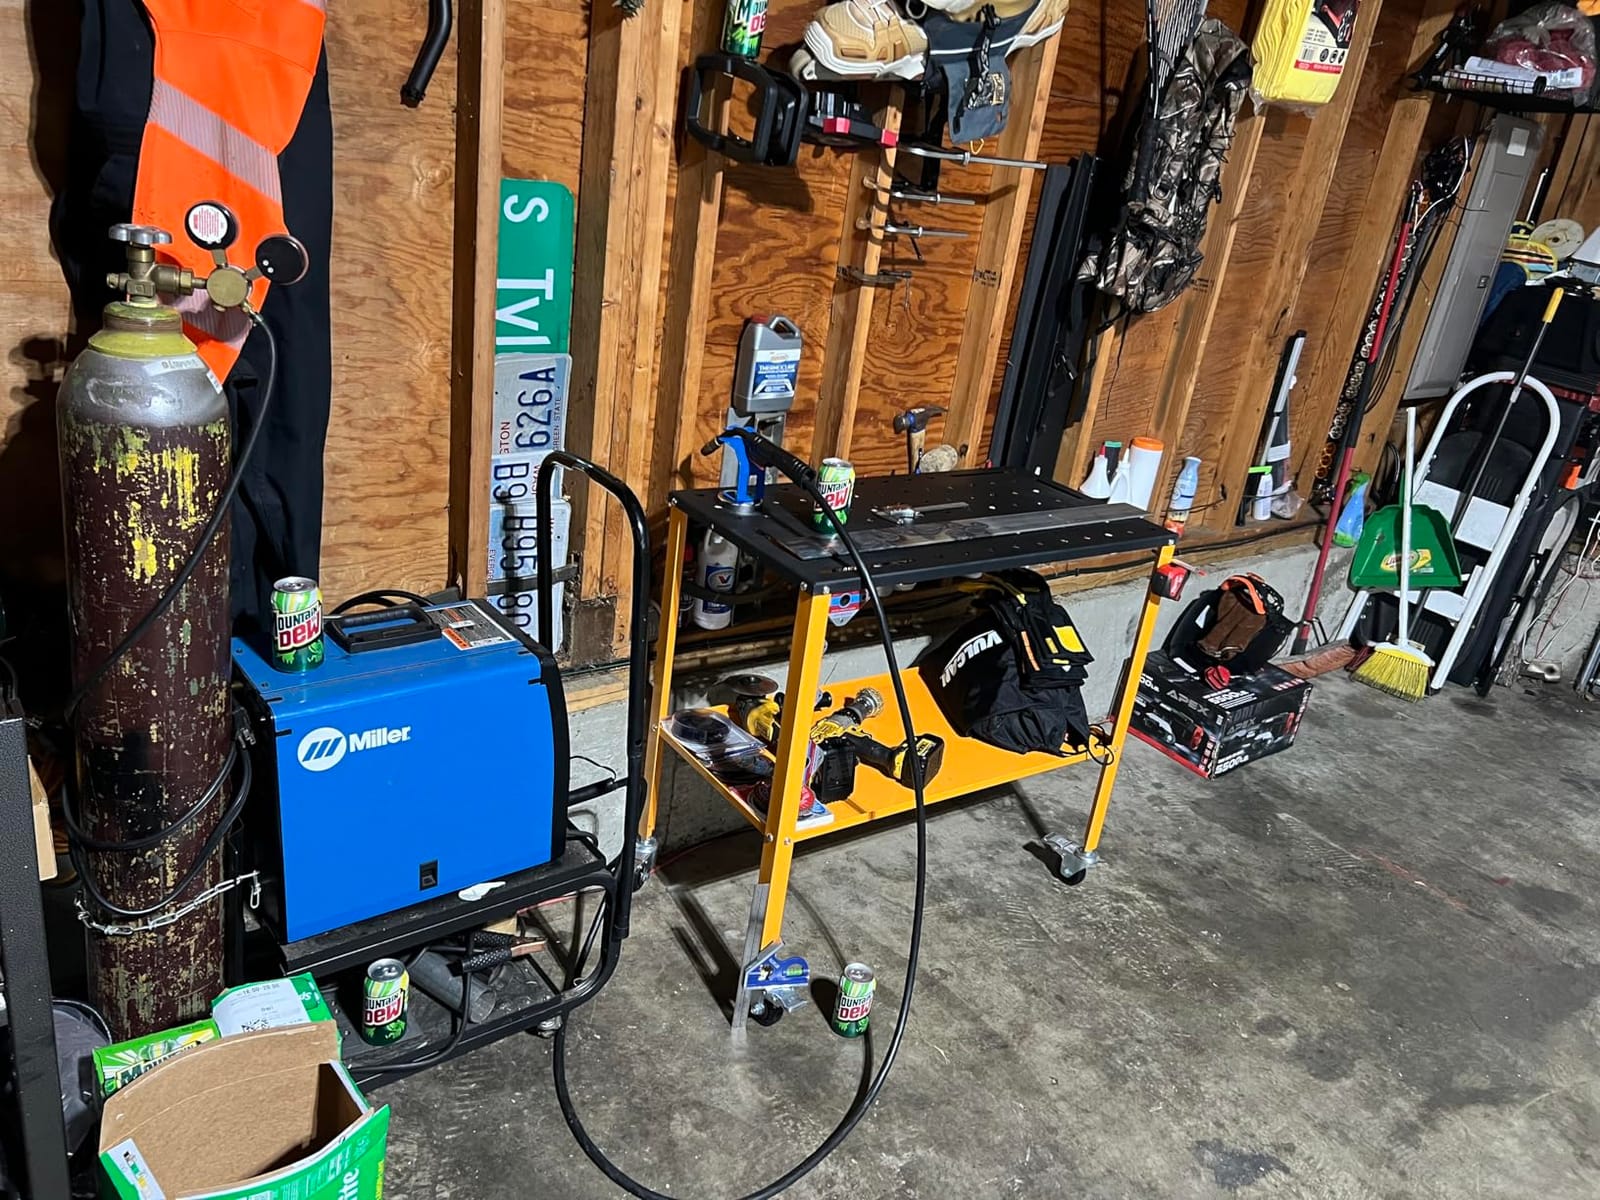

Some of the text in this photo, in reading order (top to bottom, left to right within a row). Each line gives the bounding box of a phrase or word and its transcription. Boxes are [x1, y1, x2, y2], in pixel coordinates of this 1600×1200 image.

[503, 194, 549, 223] S
[278, 606, 319, 631] OUNTAIN
[939, 629, 1003, 688] VULCAN
[1165, 689, 1210, 717] APEX
[349, 726, 411, 753] Miller
